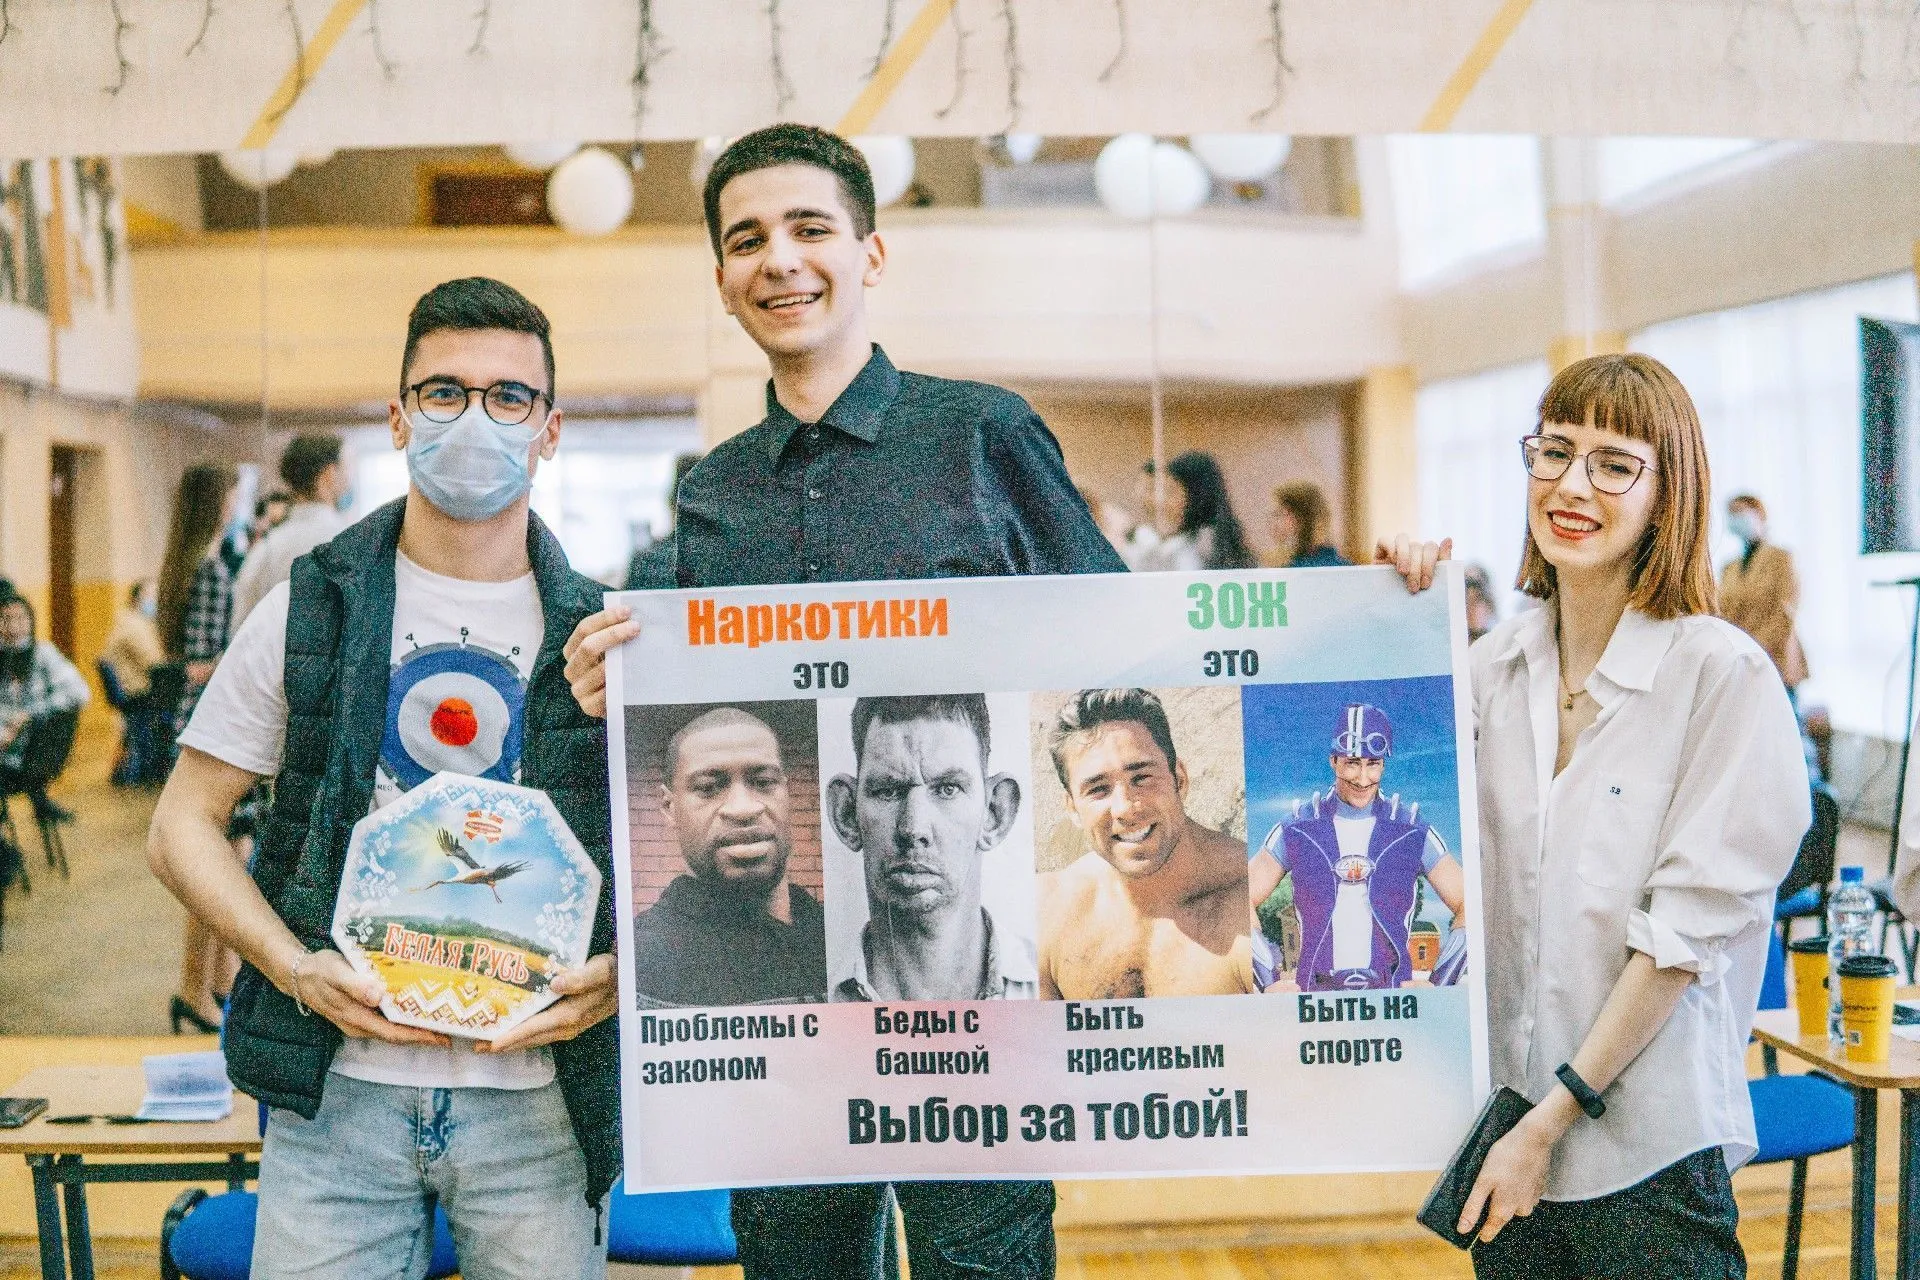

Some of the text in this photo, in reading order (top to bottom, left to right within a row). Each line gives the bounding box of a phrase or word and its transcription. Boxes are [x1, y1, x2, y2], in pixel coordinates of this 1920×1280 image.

[1186, 581, 1289, 630] ЗОЖ
[687, 597, 949, 648] Наркотики
[405, 627, 520, 656] 4 5 6
[793, 660, 850, 689] это
[1203, 649, 1260, 677] это
[384, 923, 464, 970] БЕЛАЯ
[874, 1006, 980, 1038] Беды с
[1066, 1002, 1144, 1032] Быть
[1299, 992, 1419, 1023] Быть на
[641, 1013, 819, 1046] Проблемы с
[875, 1045, 990, 1076] башкой
[1067, 1044, 1225, 1075] красивым
[1299, 1037, 1402, 1066] спорте
[642, 1056, 767, 1085] законом
[848, 1087, 1249, 1148] Выбор за тобой!
